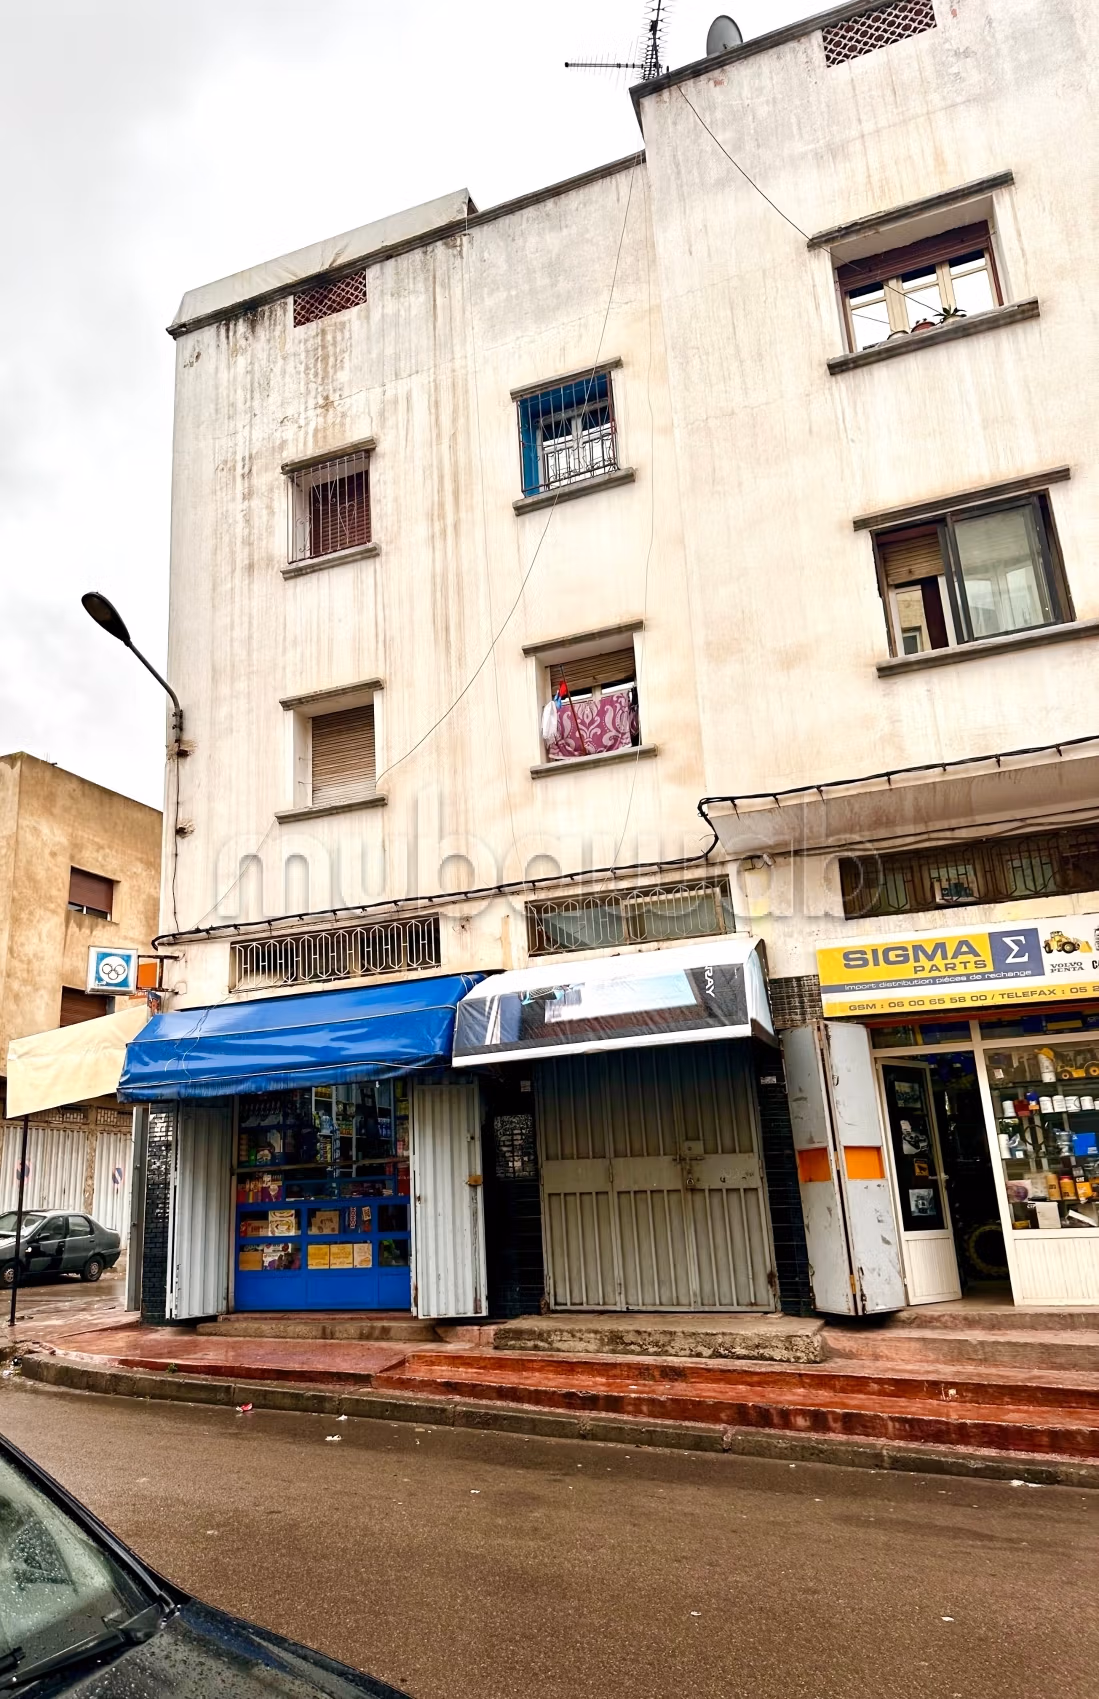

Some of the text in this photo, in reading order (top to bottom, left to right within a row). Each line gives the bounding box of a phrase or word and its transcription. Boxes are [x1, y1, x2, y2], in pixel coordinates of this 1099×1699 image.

[842, 940, 982, 969] SIGMA
[914, 960, 988, 974] PARTS
[879, 978, 933, 988] distribution
[970, 971, 982, 980] de
[985, 970, 1032, 979] rechange
[849, 1003, 876, 1011] GSM
[999, 989, 1057, 1000] TELEFAX
